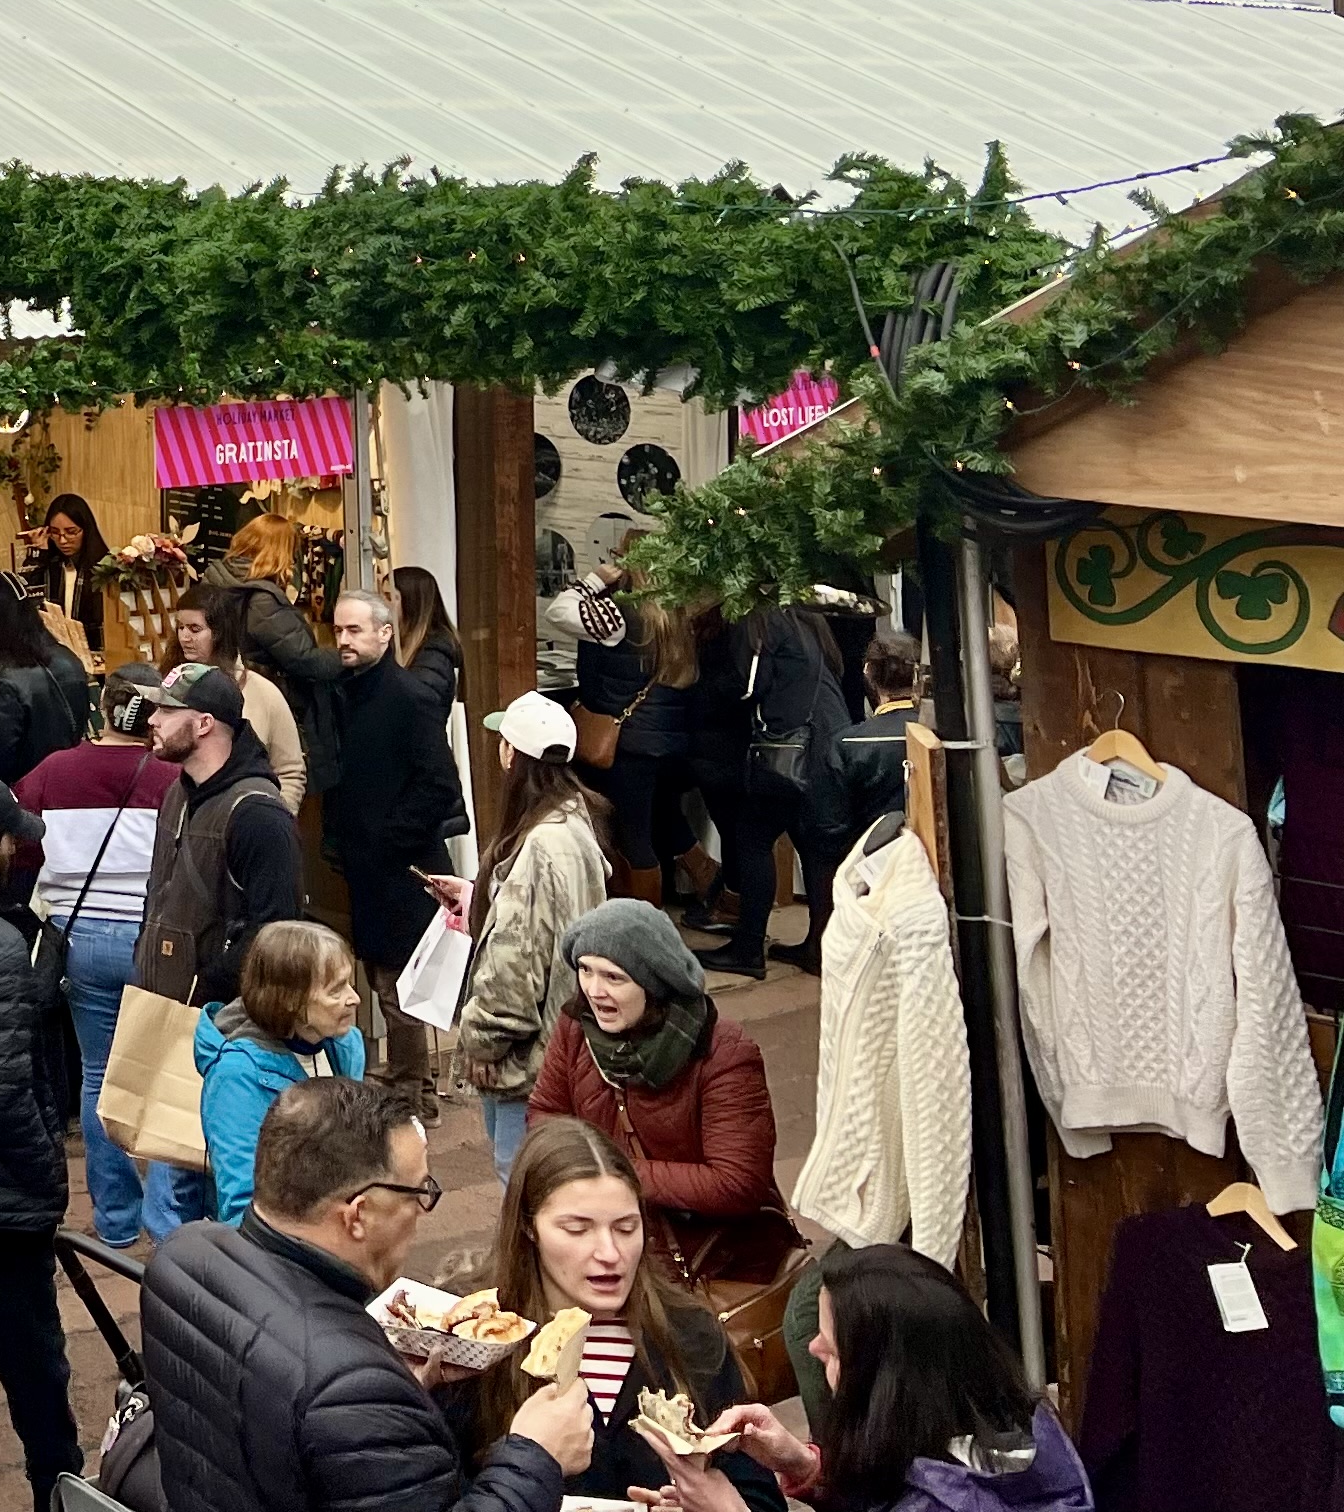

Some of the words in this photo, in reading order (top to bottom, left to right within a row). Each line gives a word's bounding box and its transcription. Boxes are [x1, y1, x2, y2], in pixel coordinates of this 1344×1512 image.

[216, 411, 257, 425] HOLIDAY
[260, 408, 295, 423] MARKET
[762, 406, 794, 427] LOST
[215, 439, 298, 465] GRATINSTA
